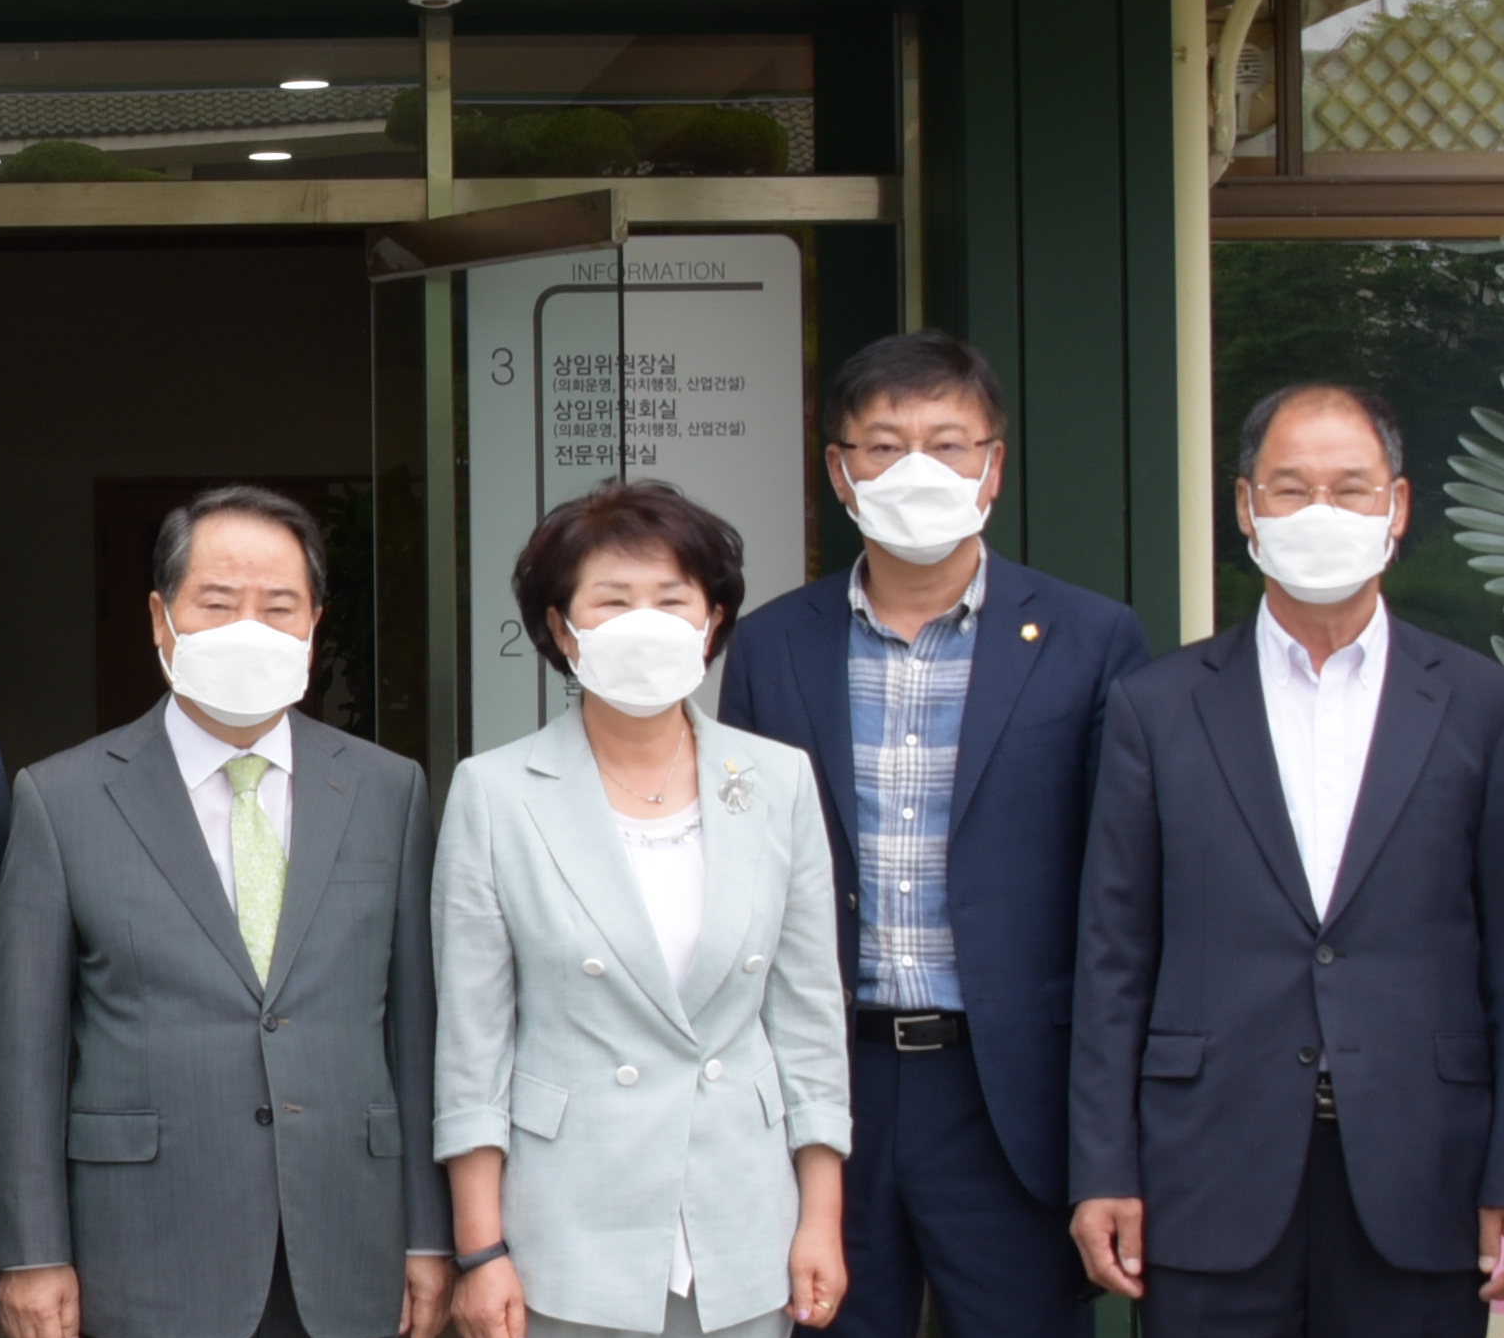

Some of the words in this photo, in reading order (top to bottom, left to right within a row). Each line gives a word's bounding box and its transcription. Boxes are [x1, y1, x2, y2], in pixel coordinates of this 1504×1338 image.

[572, 262, 726, 282] INFORMATION
[491, 347, 515, 386] 3
[552, 353, 677, 377] 상임위원장실
[686, 376, 746, 392] 산업건설)
[553, 398, 677, 422] 상임위원회실
[686, 421, 746, 437] 산업건설)
[554, 443, 657, 466] 전문위원실
[500, 620, 523, 658] 2
